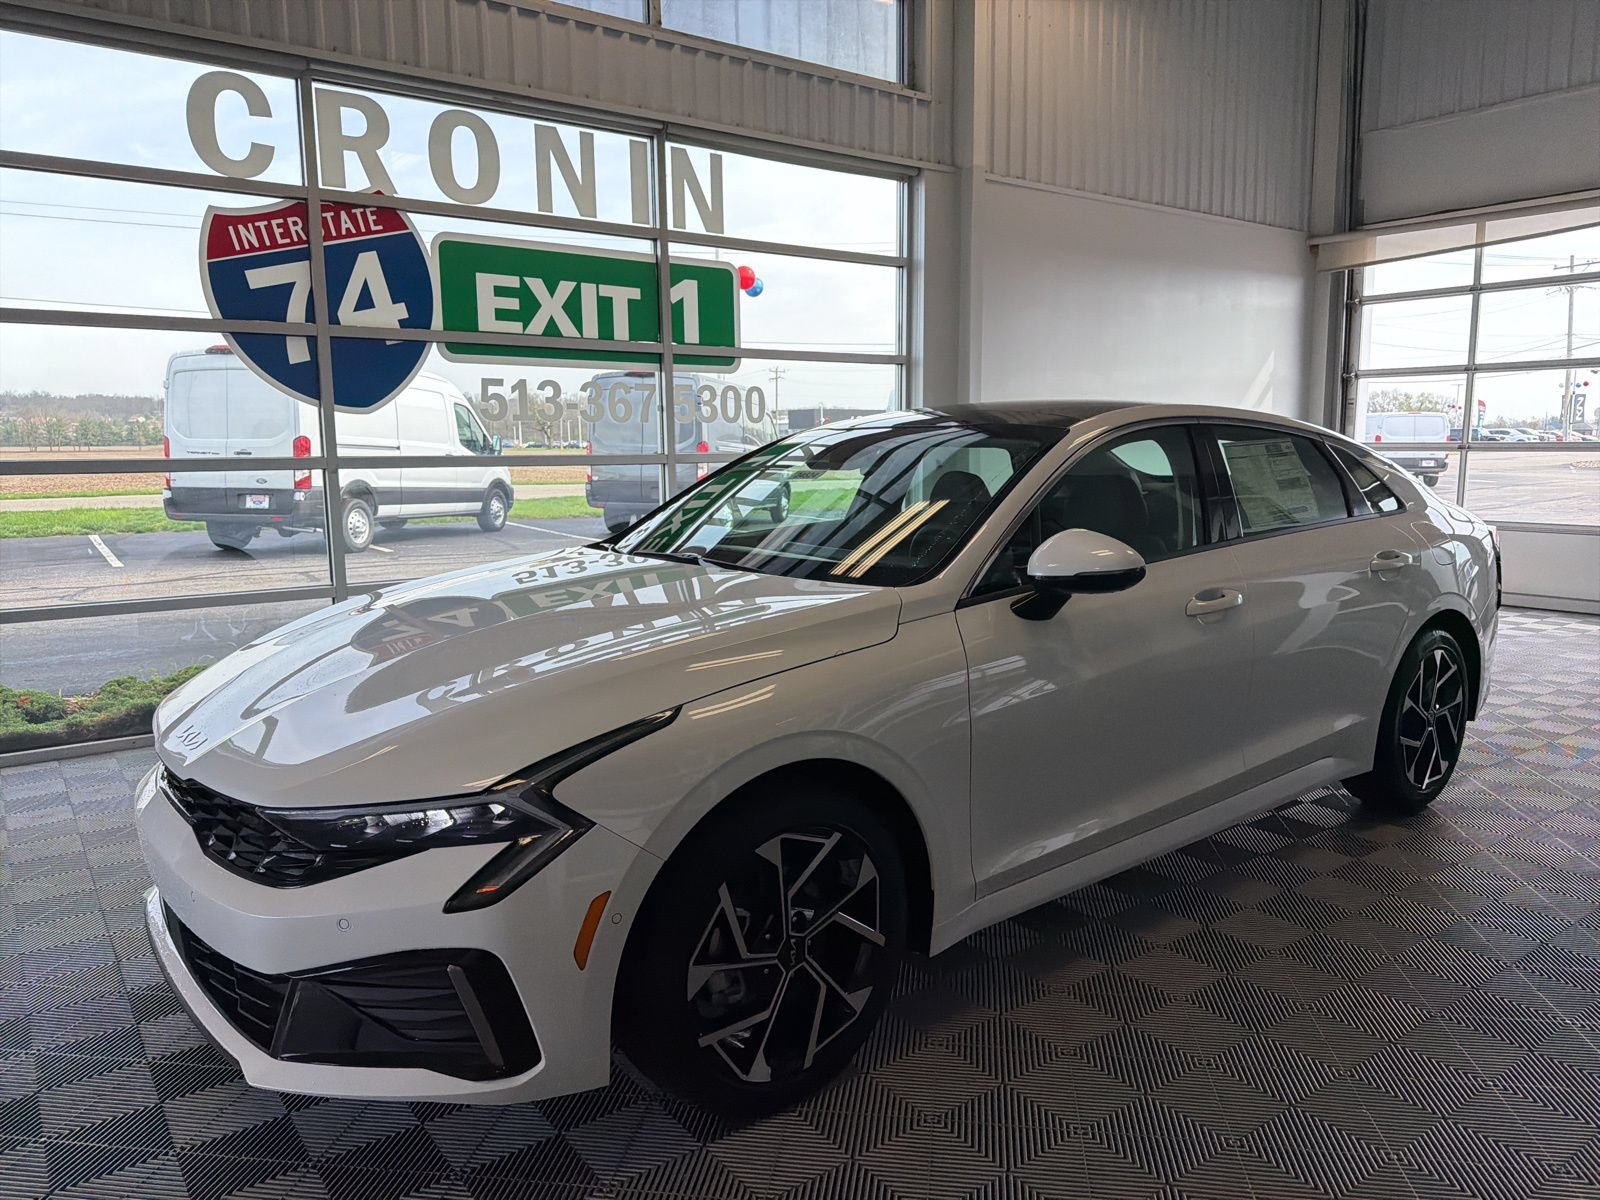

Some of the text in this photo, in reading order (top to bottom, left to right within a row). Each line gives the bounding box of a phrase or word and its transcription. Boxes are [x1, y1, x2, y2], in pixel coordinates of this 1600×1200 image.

[185, 71, 725, 235] CRONIN
[228, 207, 384, 251] INTERTATE
[244, 250, 410, 365] 74
[475, 272, 700, 344] EXIT 1
[479, 377, 766, 424] 513-3675300
